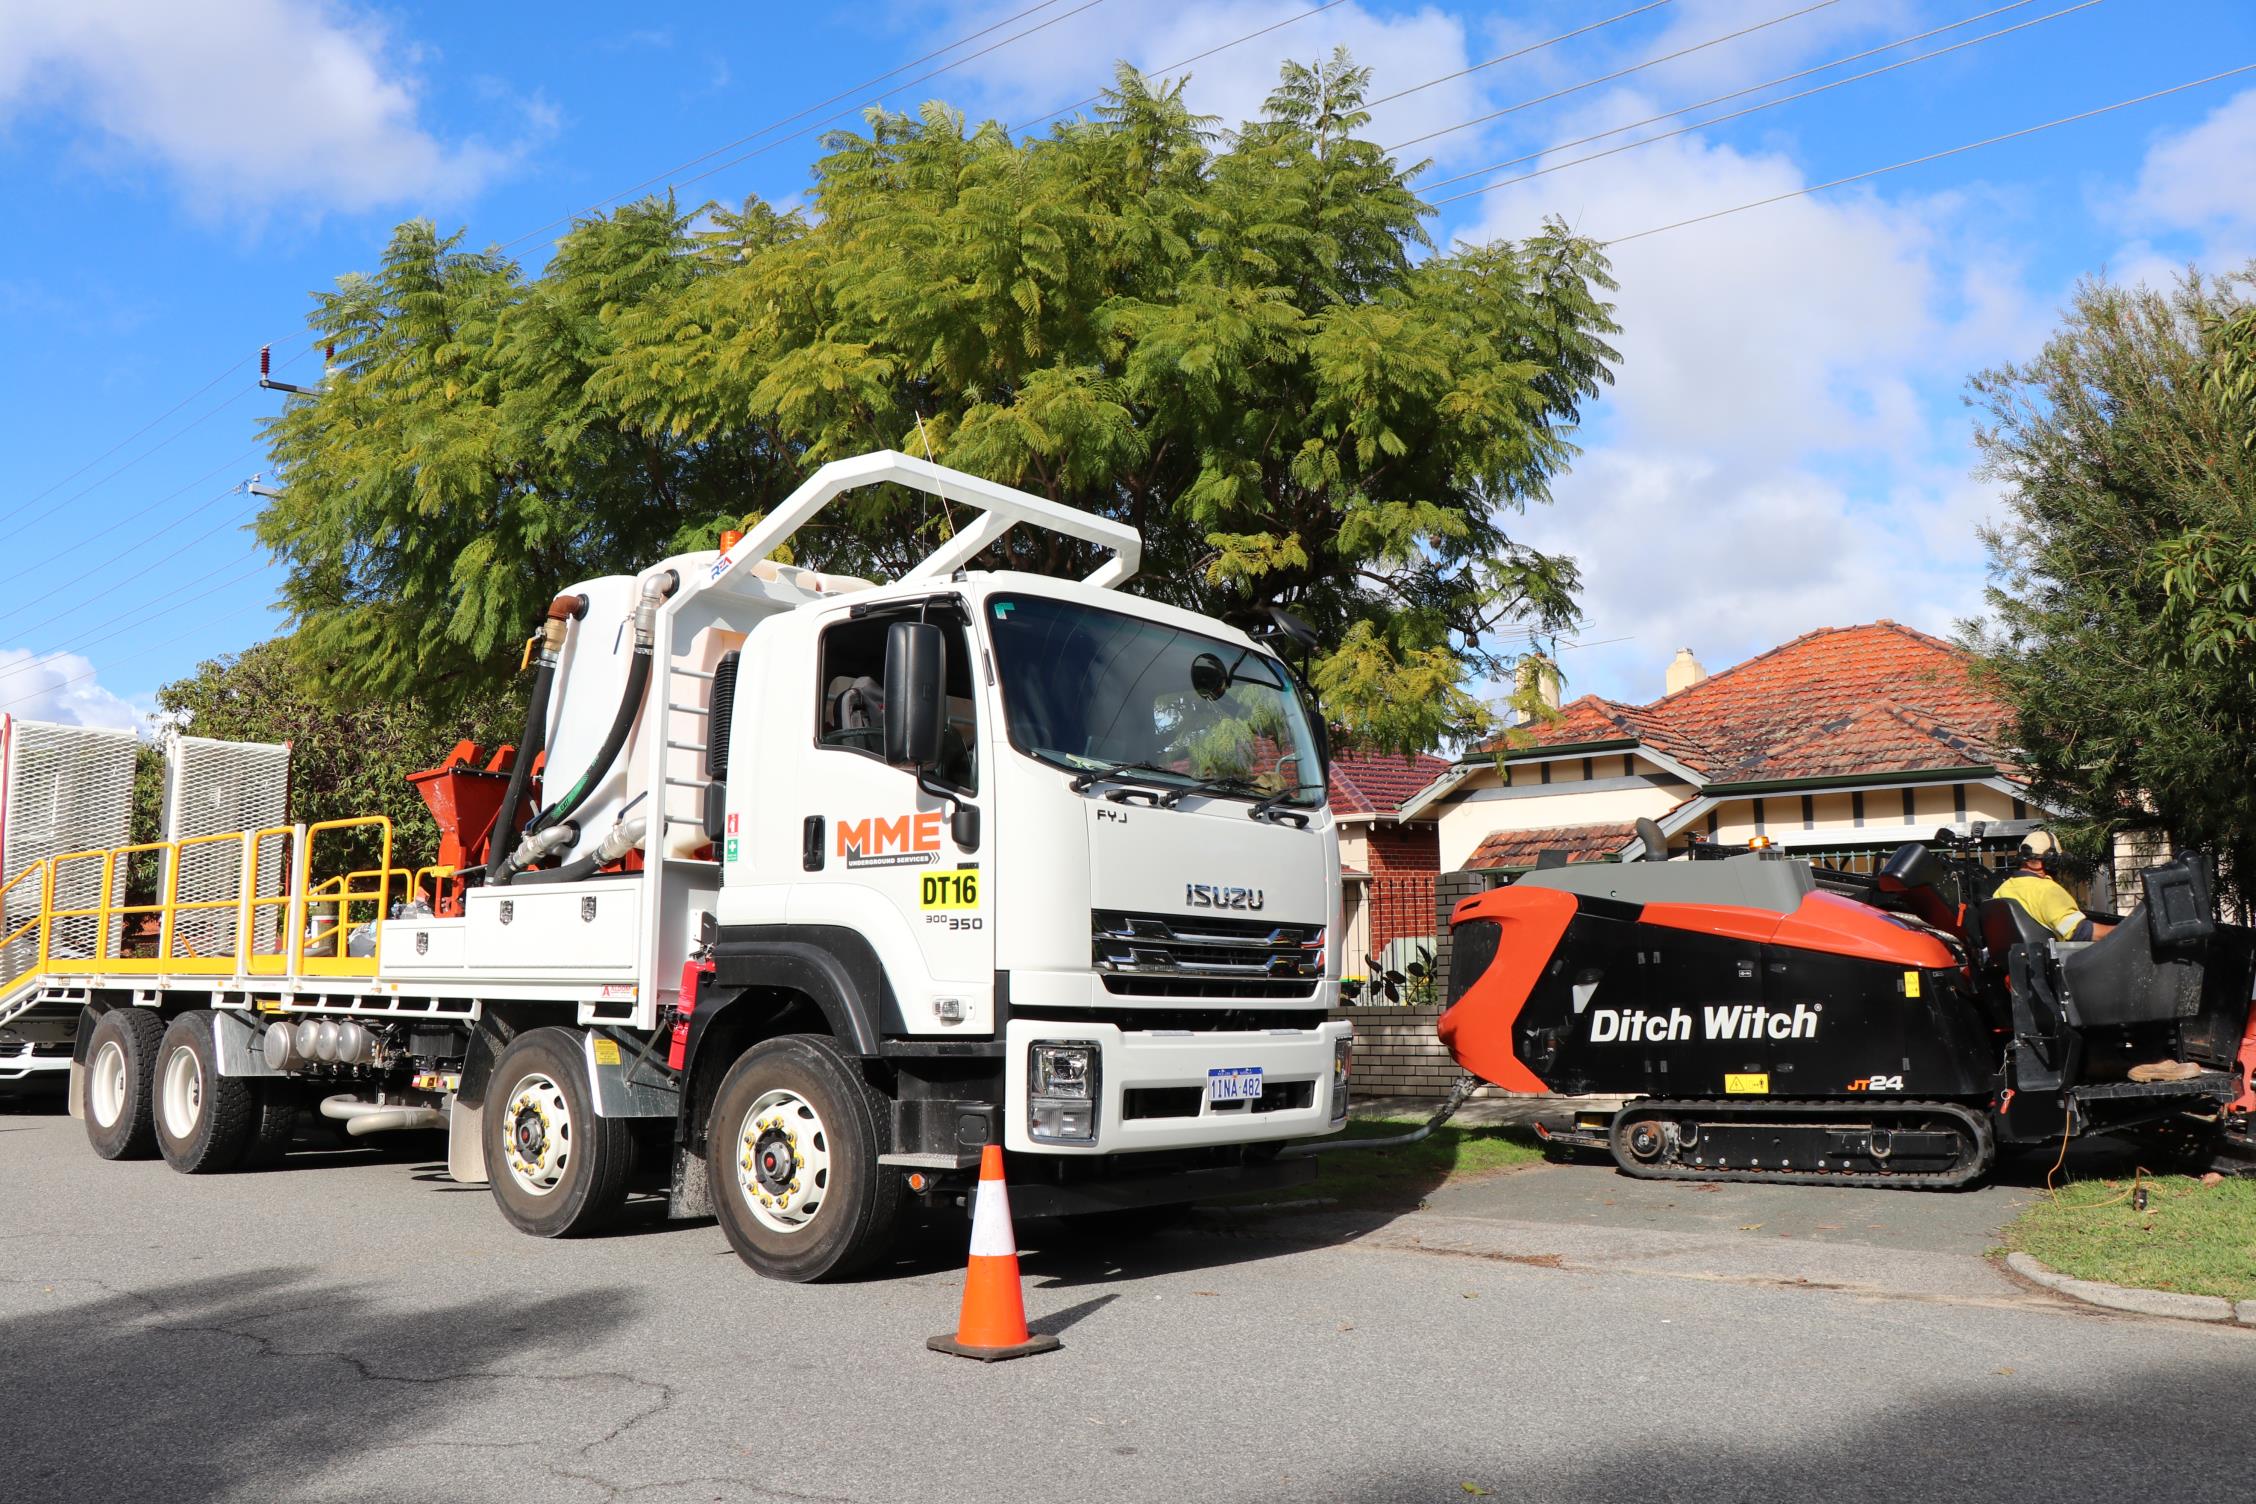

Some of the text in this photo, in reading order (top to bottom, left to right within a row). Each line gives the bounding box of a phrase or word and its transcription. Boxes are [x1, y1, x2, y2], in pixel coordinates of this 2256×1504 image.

[1097, 809, 1127, 823] FYJ
[837, 812, 942, 857] MME
[848, 855, 929, 867] UNDERGROUND SERVICES
[923, 875, 977, 904] DT16
[1186, 883, 1263, 911] ISUZU
[926, 915, 983, 930] 300 350
[1590, 1007, 1692, 1042] Ditch
[1847, 1075, 1904, 1090] JT24
